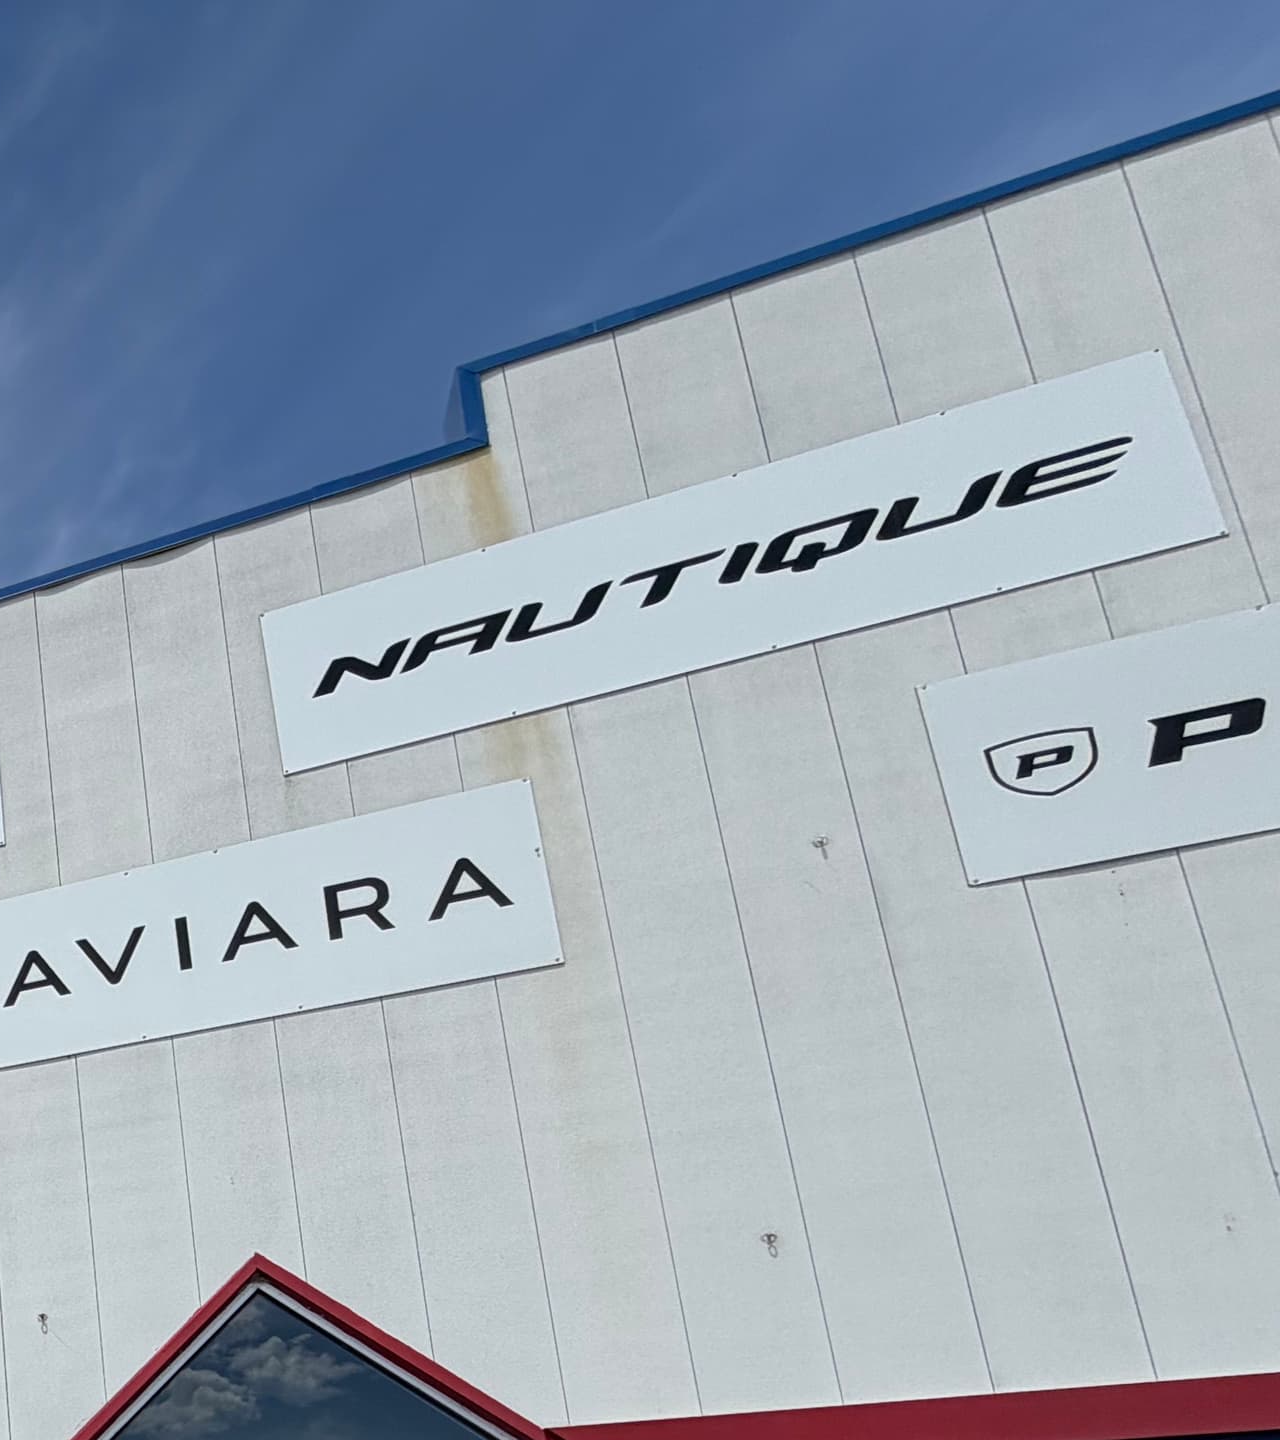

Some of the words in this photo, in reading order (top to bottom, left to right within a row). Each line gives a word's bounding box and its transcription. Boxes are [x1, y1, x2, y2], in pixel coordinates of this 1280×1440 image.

[311, 435, 1134, 699] NAUTIQUE
[1016, 745, 1075, 780] P
[2, 856, 515, 1009] AVIARA
